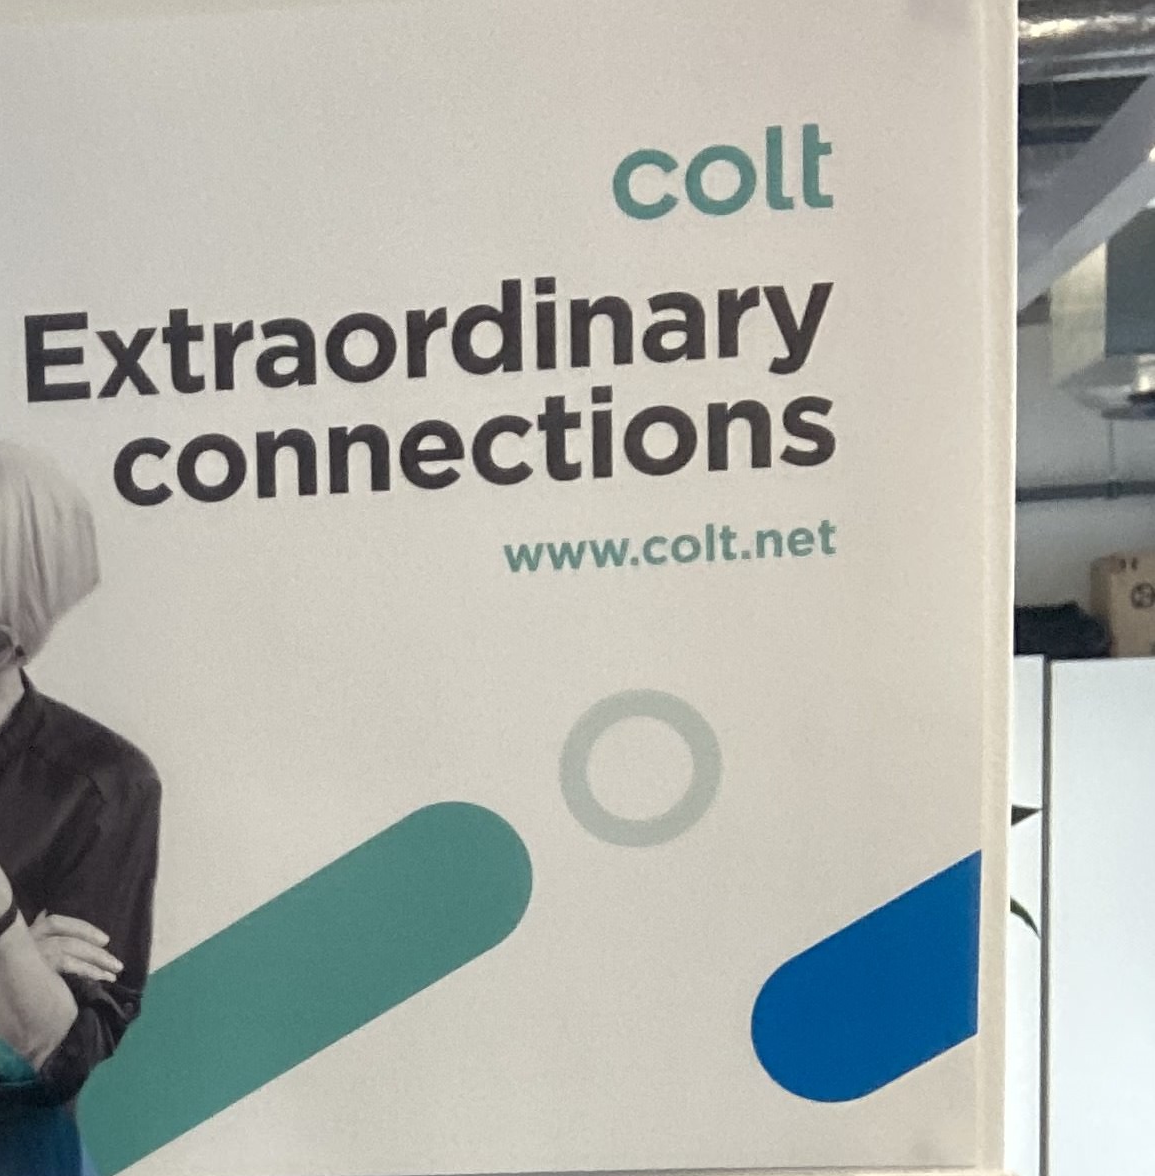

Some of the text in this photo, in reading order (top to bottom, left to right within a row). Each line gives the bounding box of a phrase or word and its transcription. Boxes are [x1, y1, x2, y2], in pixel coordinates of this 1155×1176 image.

[612, 124, 834, 220] colt
[23, 276, 834, 403] Extraordinary
[112, 386, 836, 507] connections
[503, 519, 837, 574] www.colt.net
